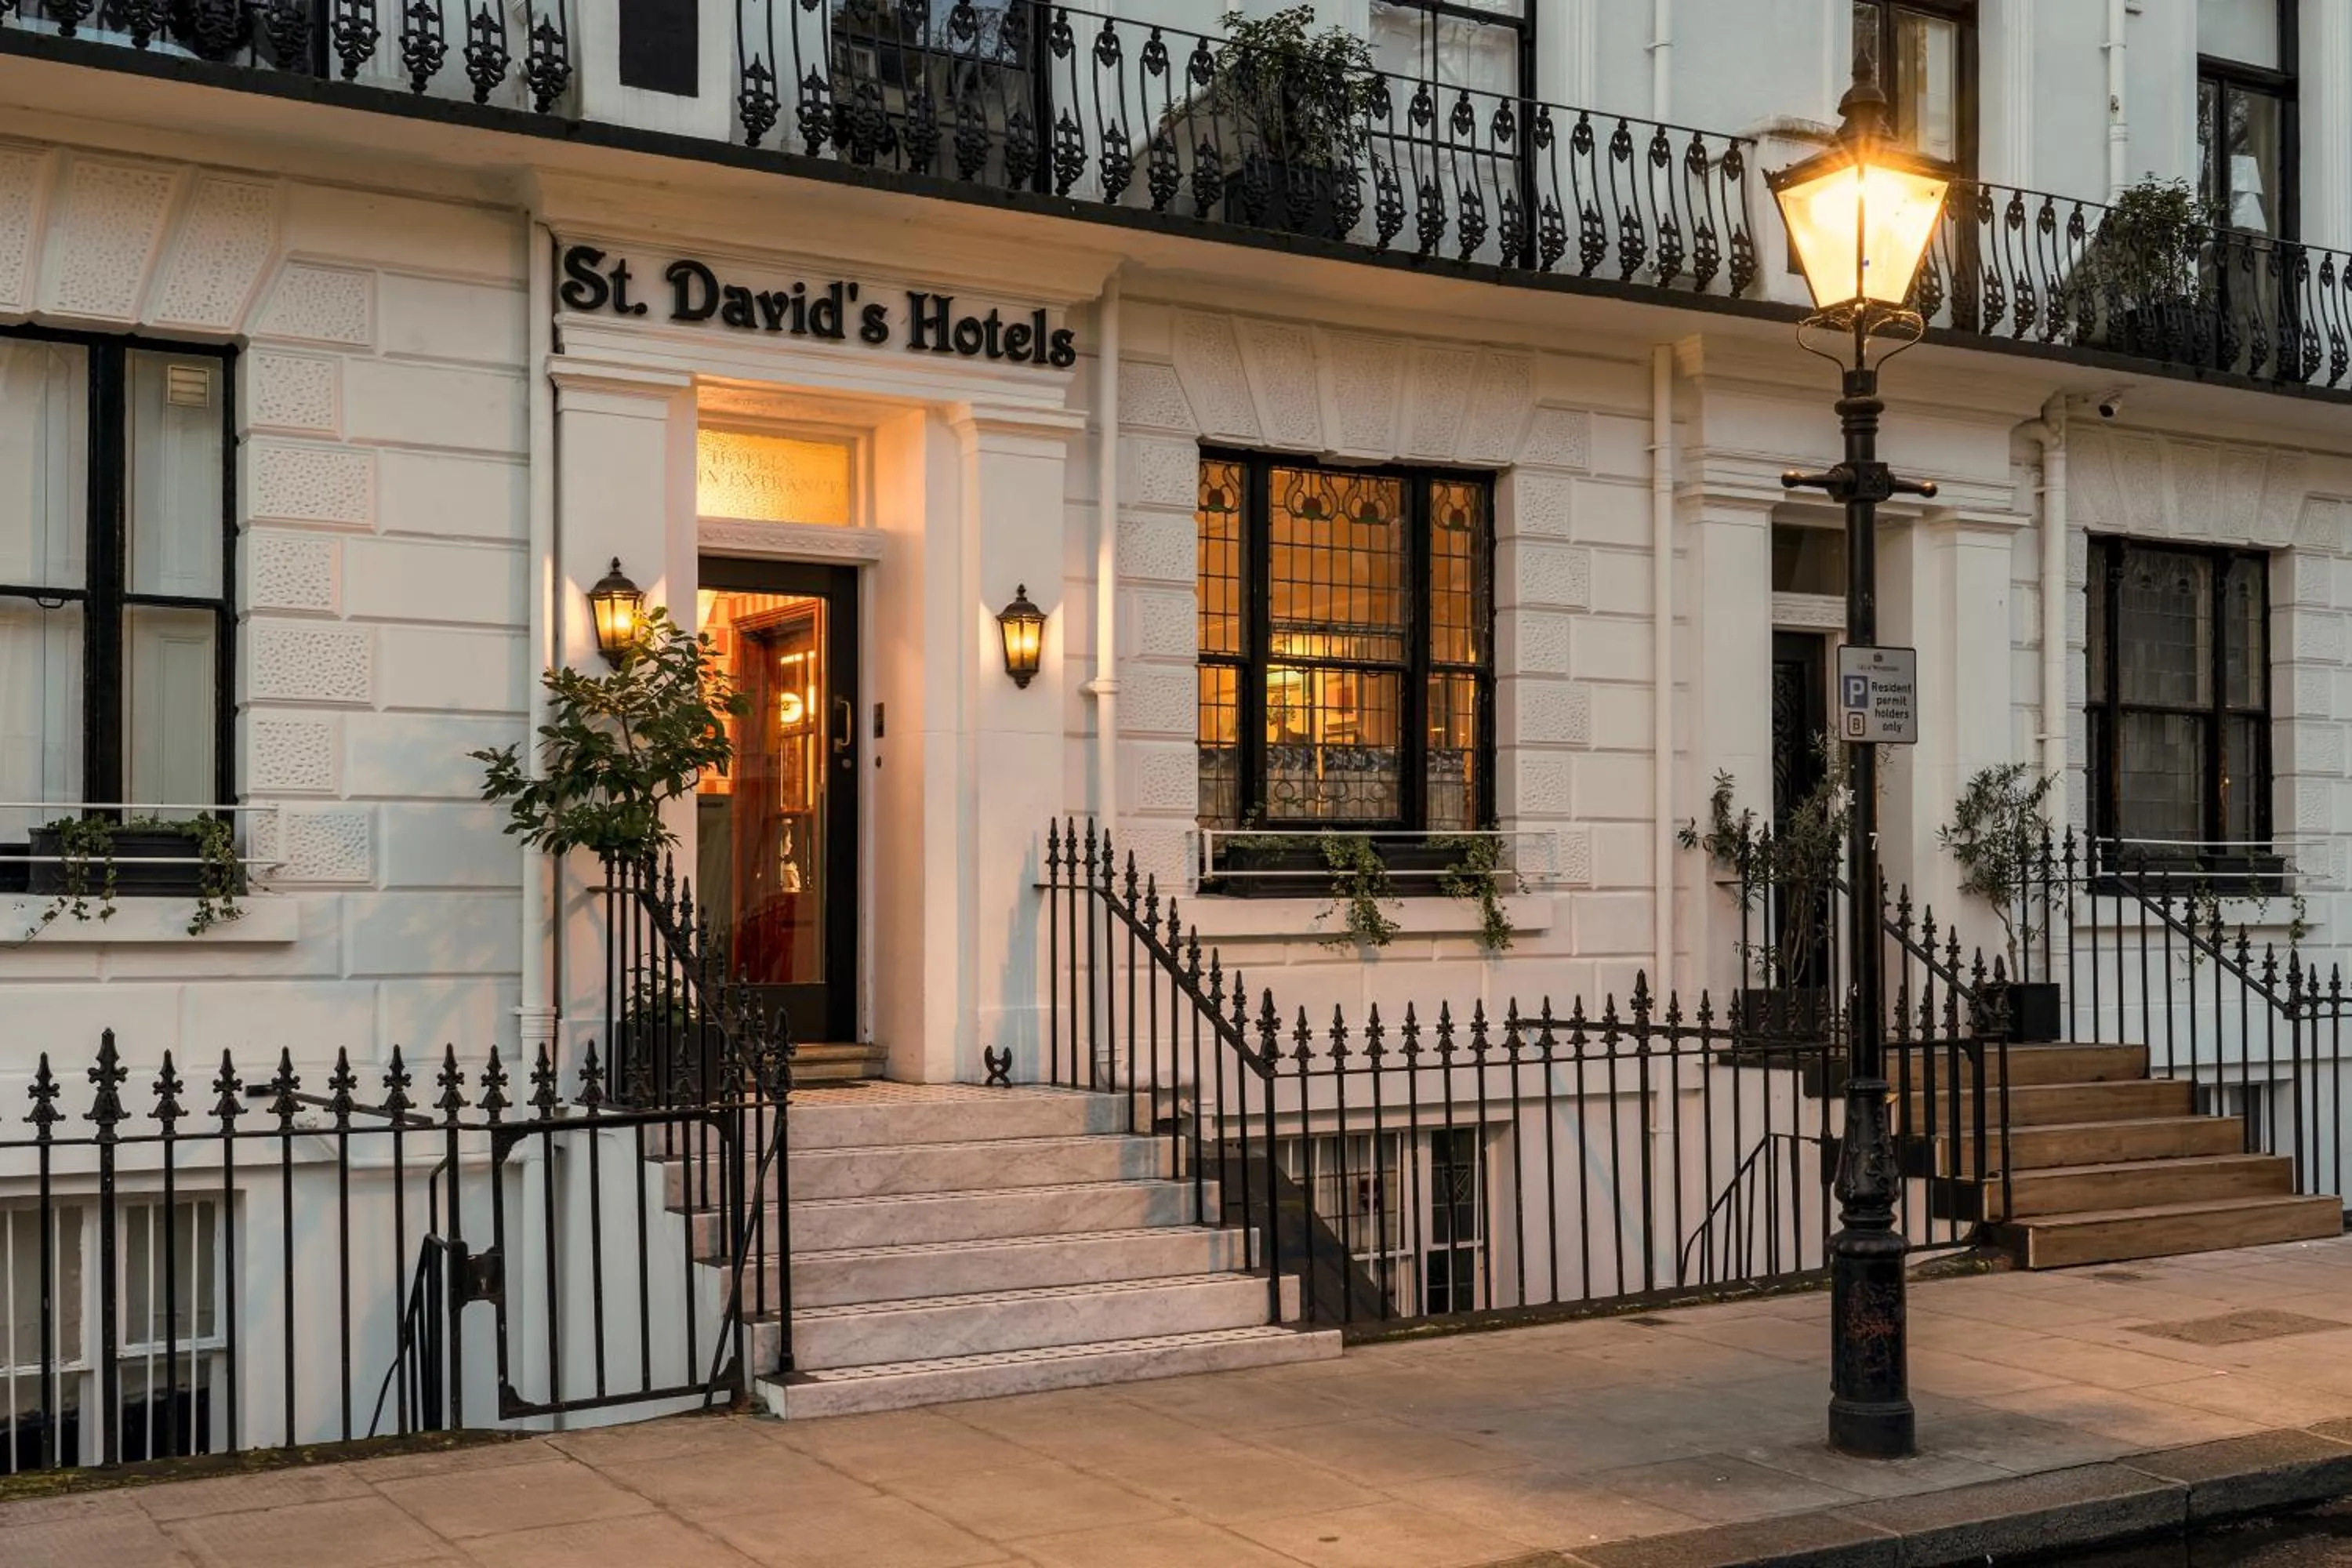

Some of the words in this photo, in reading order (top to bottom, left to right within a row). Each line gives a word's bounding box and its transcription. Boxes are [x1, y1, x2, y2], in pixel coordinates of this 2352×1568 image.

[561, 245, 648, 315] St.
[666, 260, 889, 344] David's
[906, 291, 1076, 368] Hotels
[1849, 679, 1865, 705] P
[1871, 681, 1911, 693] Resident
[1876, 695, 1907, 706] permit
[1875, 708, 1909, 719] holders
[1882, 721, 1903, 732] only
